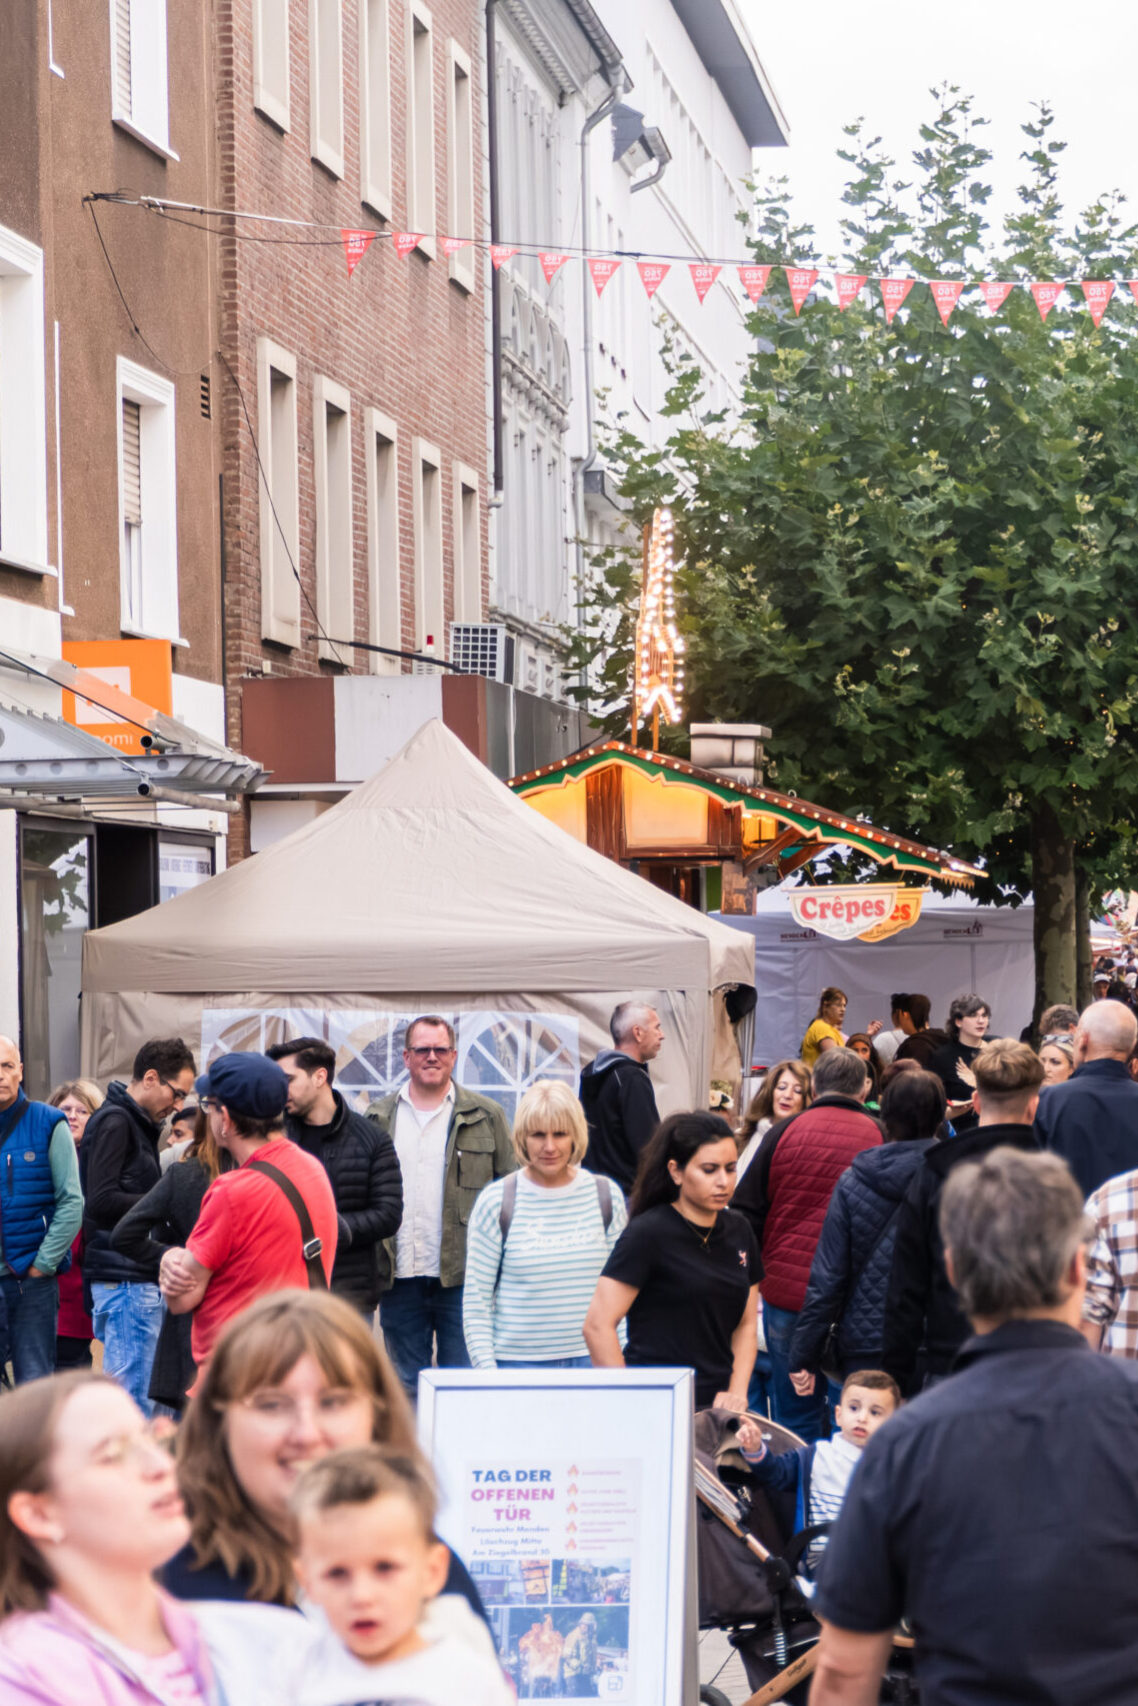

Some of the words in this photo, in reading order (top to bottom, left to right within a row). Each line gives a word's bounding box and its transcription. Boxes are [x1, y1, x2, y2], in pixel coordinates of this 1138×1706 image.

[800, 896, 886, 923] Crêpes
[472, 1470, 512, 1482] TAG
[516, 1470, 552, 1482] DER
[471, 1488, 555, 1502] OFFENEN
[494, 1505, 531, 1521] TÜR
